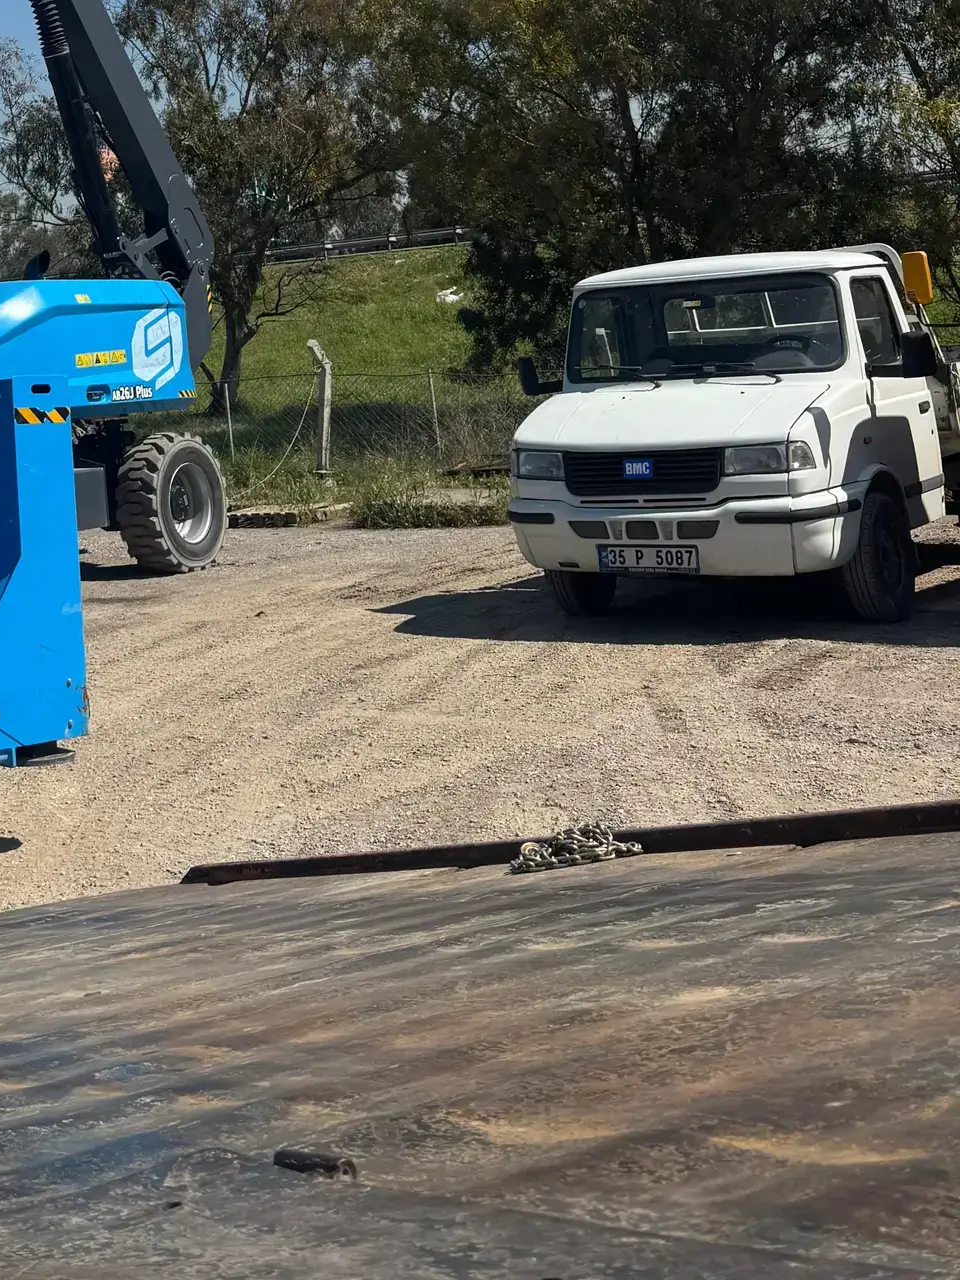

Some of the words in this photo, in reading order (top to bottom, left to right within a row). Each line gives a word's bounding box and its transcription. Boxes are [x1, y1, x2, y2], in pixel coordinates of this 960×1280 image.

[112, 386, 134, 401] AB26J
[135, 384, 153, 399] Plus
[625, 462, 650, 475] BMC
[608, 549, 626, 565] 35
[635, 549, 644, 566] P
[655, 549, 693, 566] 5087
